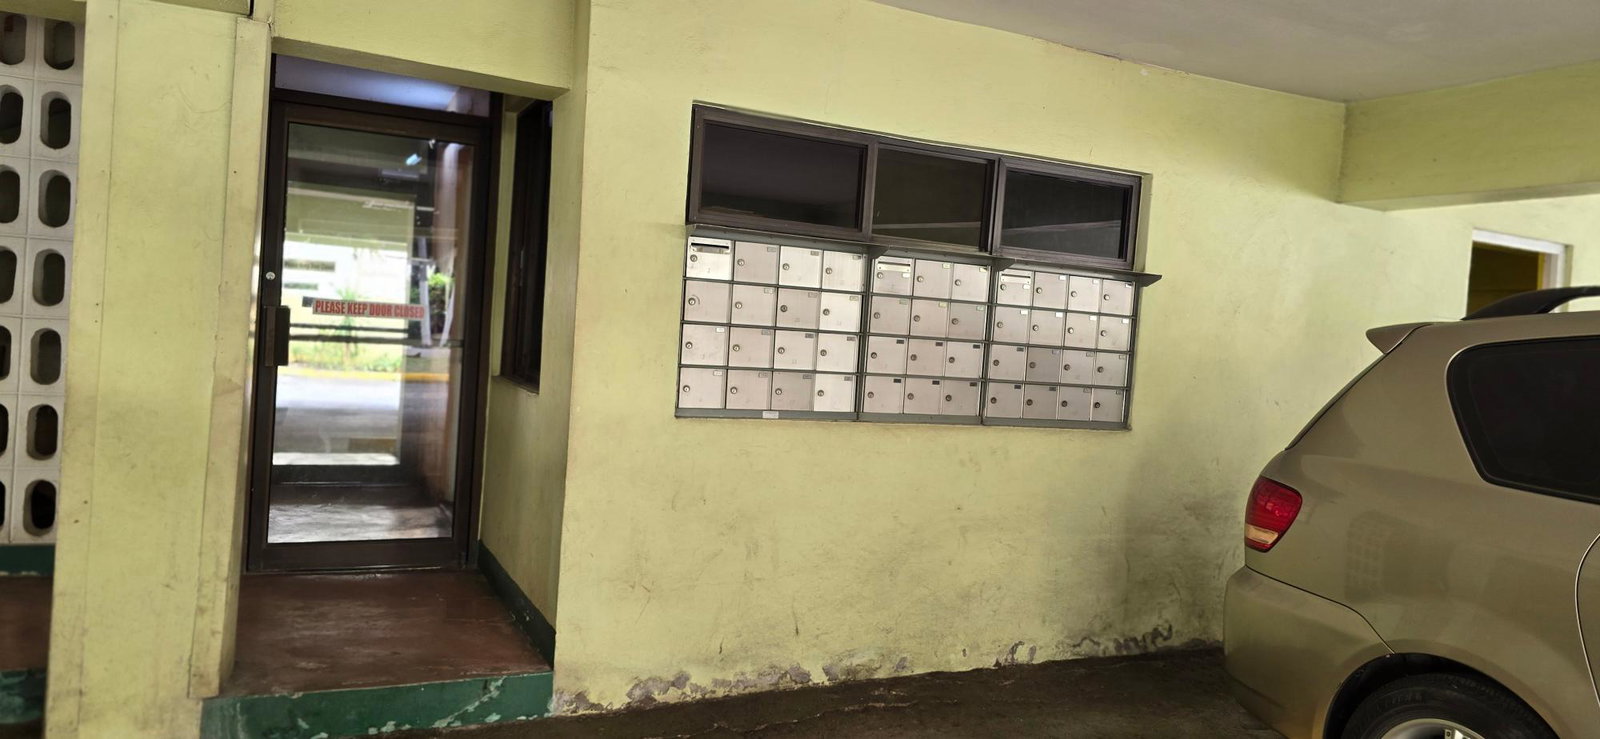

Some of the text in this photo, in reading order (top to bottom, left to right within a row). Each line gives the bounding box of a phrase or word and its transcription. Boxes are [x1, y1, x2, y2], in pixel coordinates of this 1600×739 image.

[315, 300, 425, 318] PLEASE KEEP DOOR CLOSED
